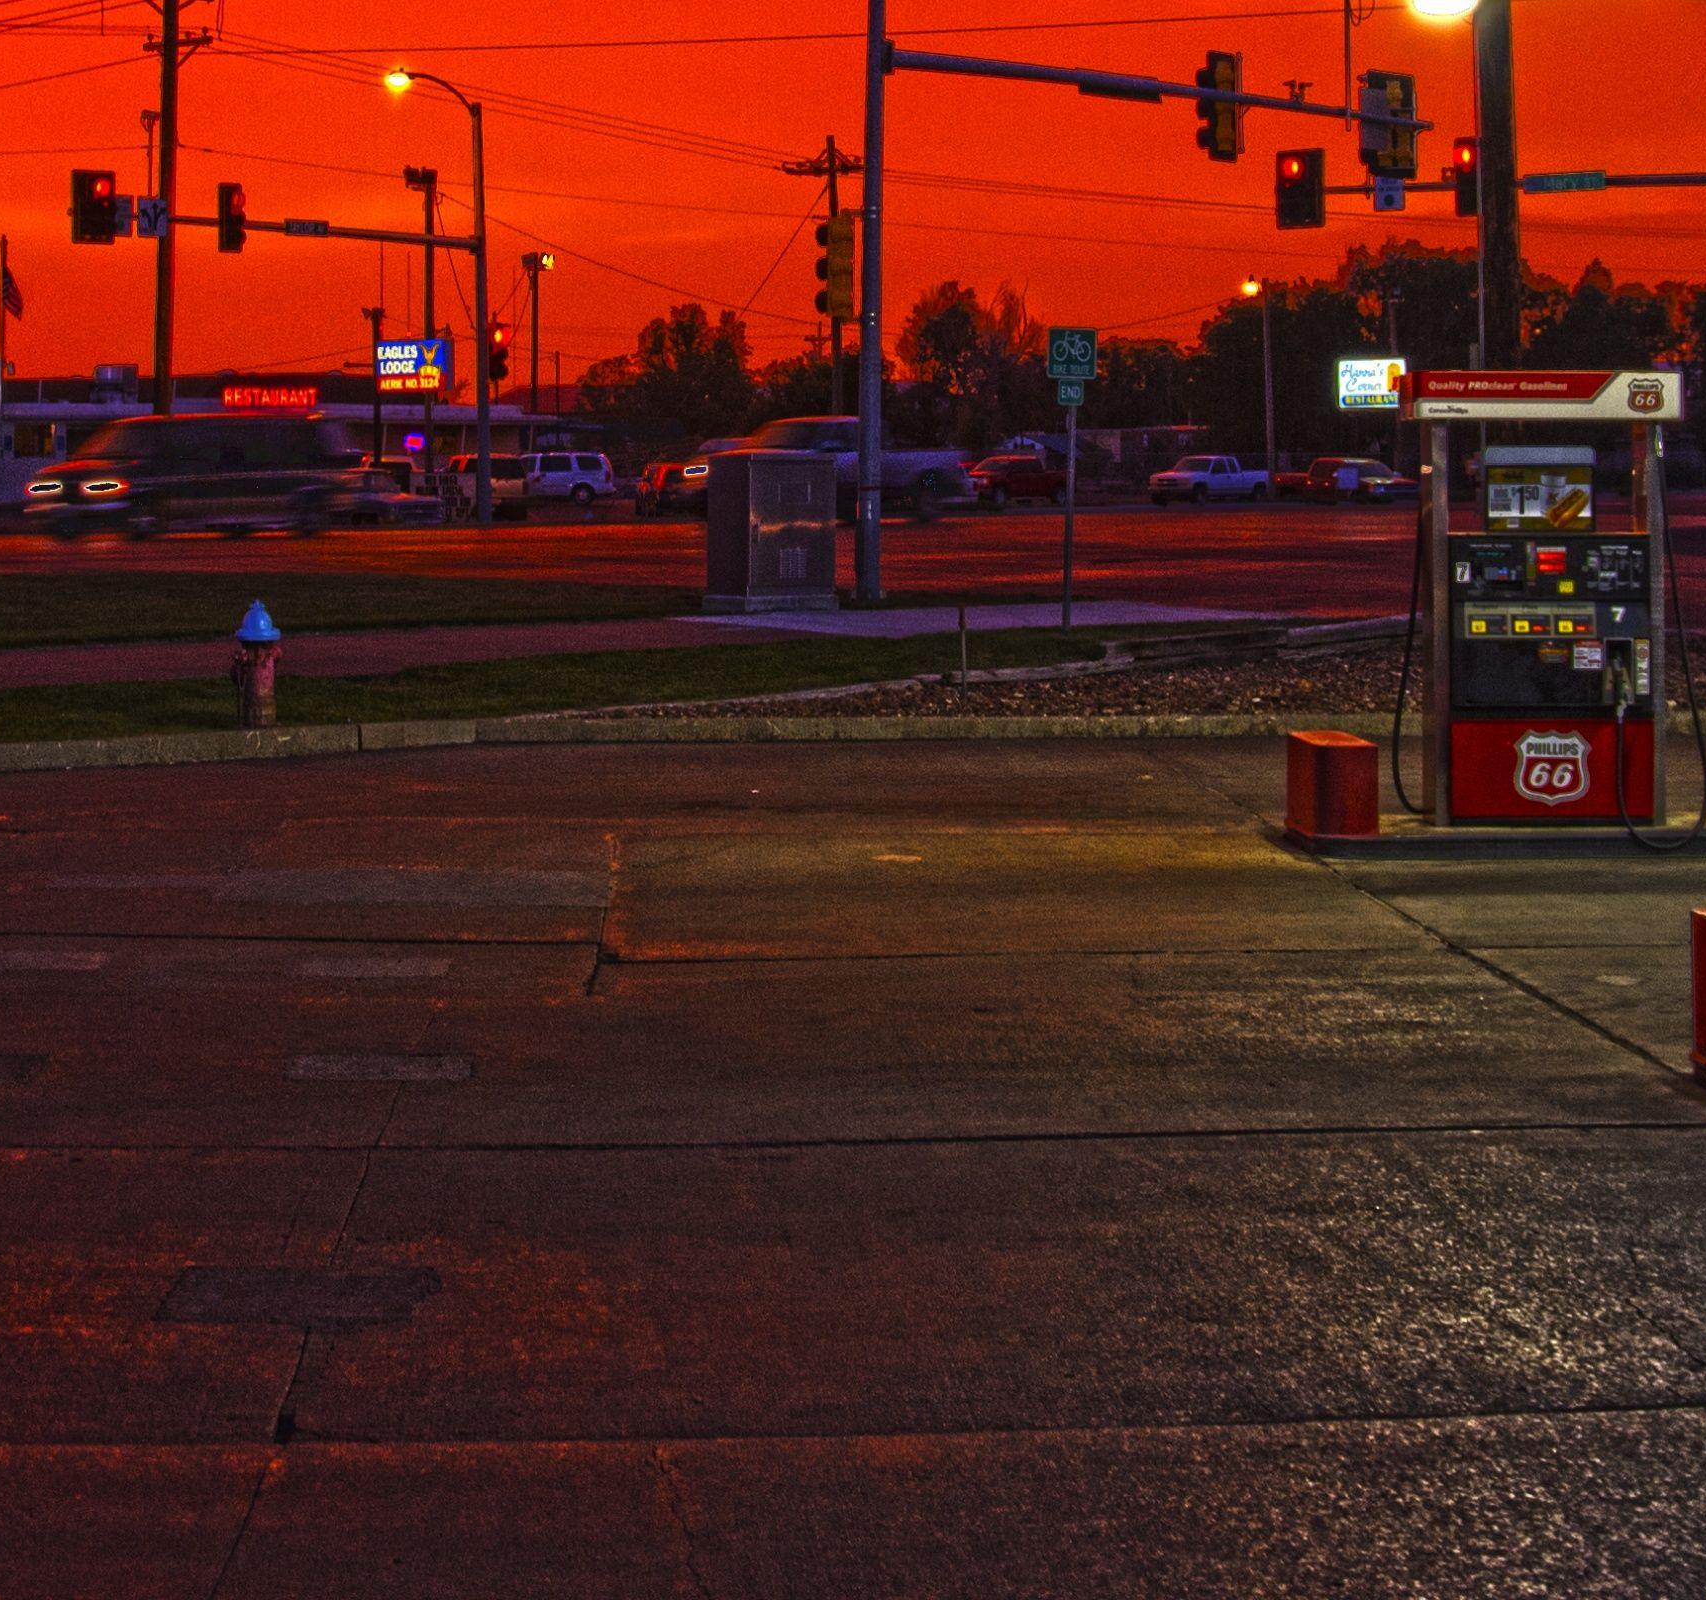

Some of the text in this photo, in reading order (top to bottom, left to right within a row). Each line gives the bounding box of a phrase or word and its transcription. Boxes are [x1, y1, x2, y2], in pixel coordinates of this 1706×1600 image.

[377, 345, 418, 360] EAGLES
[380, 361, 416, 374] LODGE
[420, 378, 439, 389] 3124
[1428, 381, 1465, 392] Quality
[1520, 381, 1567, 391] Gasolines
[224, 387, 317, 406] RESTAURANT
[1061, 386, 1081, 398] END
[1635, 394, 1656, 406] 66
[1457, 563, 1468, 581] 7
[1611, 606, 1626, 623] 7
[1526, 742, 1579, 755] PHILLIPS
[1530, 762, 1574, 788] 66
